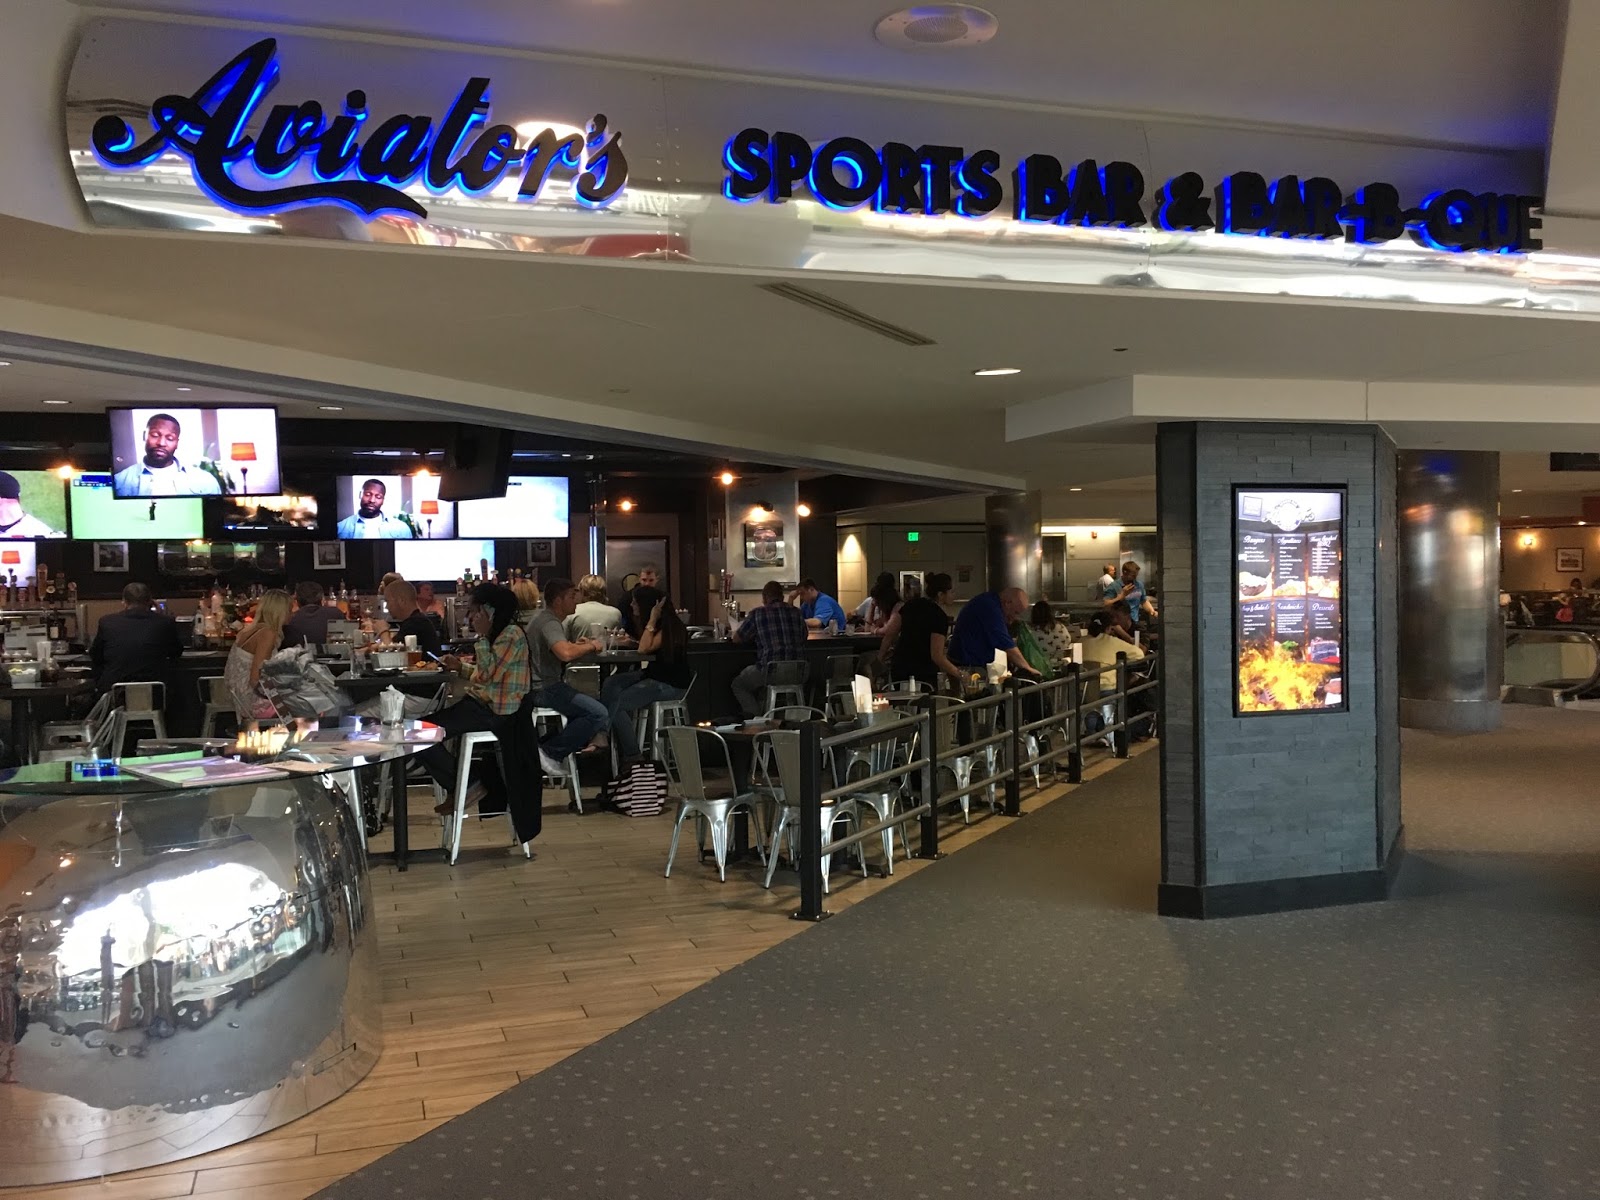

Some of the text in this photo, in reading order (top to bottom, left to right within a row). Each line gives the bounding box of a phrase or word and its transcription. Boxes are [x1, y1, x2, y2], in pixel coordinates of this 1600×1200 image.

[92, 38, 628, 218] Aviator's
[723, 127, 1543, 253] SPORTS BAR & BAR-B-QUE
